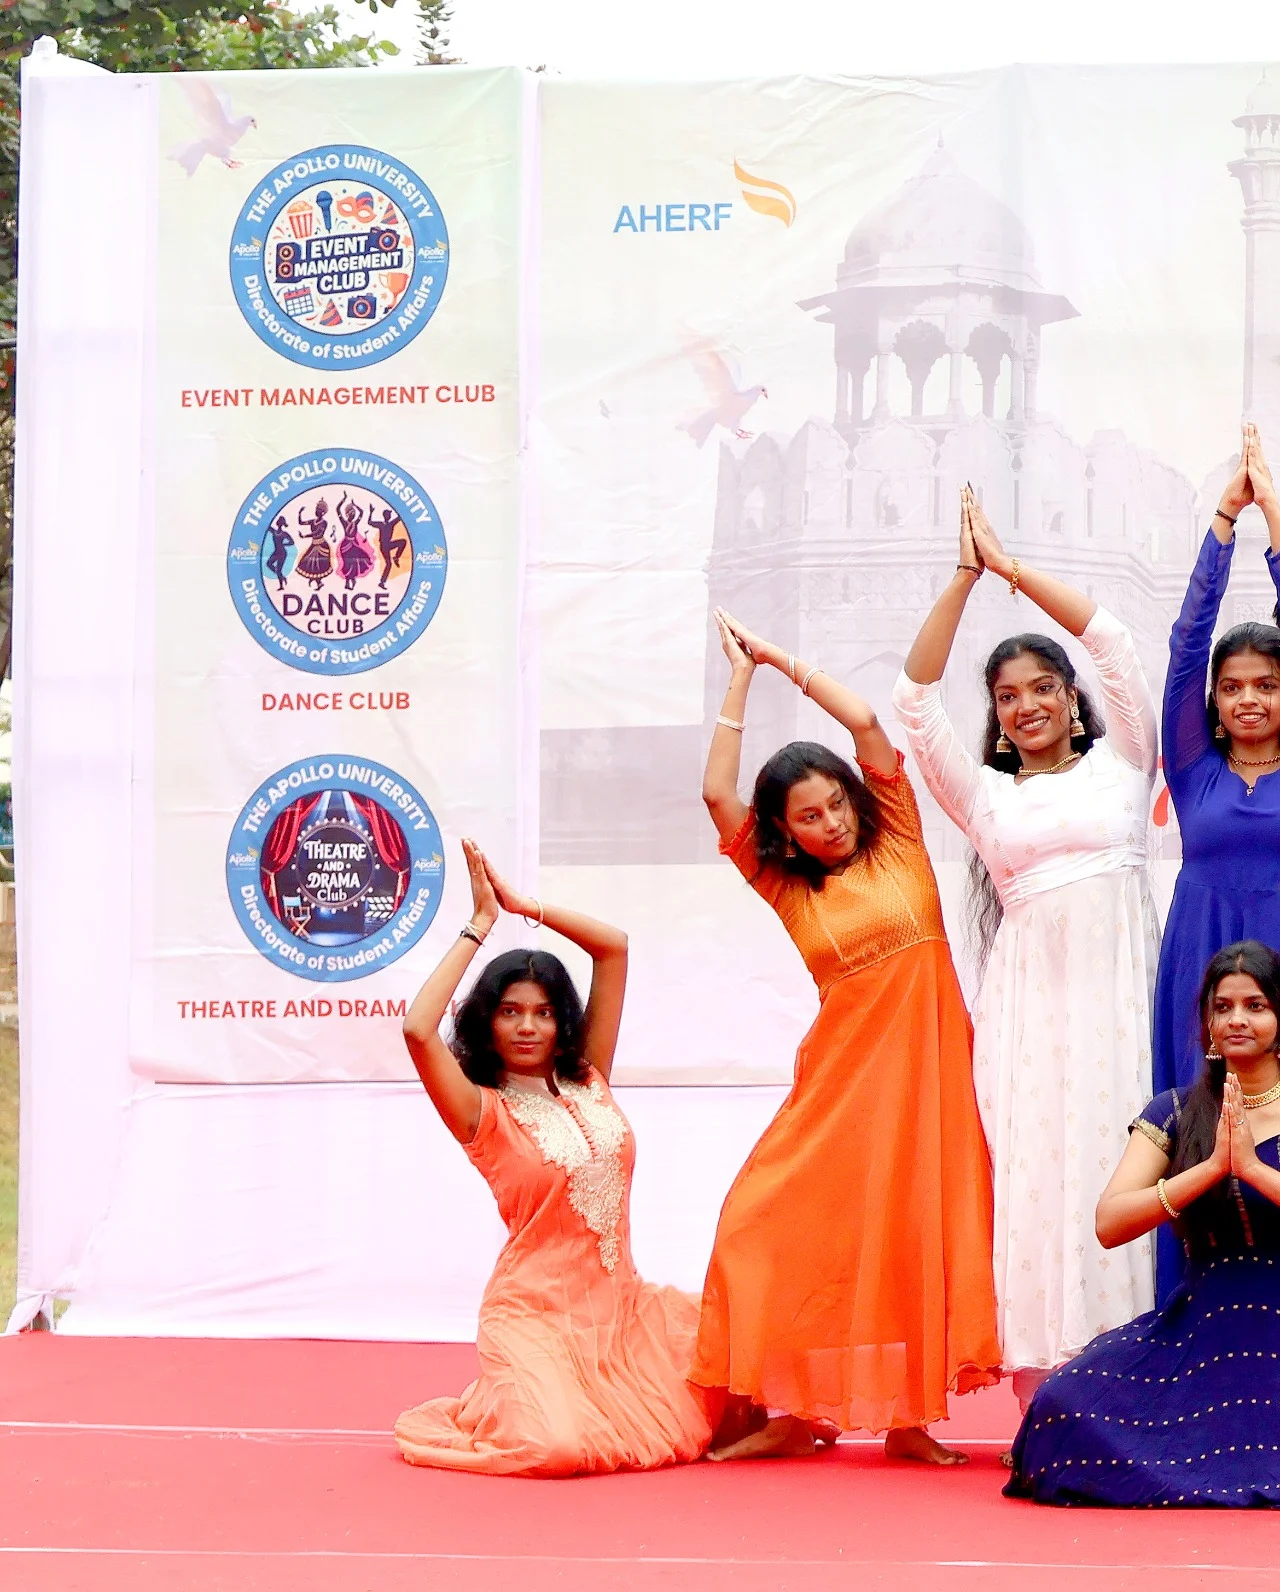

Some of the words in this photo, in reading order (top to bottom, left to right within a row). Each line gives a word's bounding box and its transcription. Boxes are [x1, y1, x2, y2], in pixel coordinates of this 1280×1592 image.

[247, 188, 276, 223] THE
[273, 153, 340, 195] APOLLO
[343, 153, 434, 219] UNIVERSITY
[613, 203, 733, 233] AHERF
[310, 235, 369, 260] EVENT
[293, 251, 401, 278] MANAGEMENT
[319, 271, 367, 293] CLUB
[244, 274, 311, 353] Directorate
[311, 343, 331, 359] of
[332, 325, 401, 360] Student
[397, 275, 434, 332] Affairs
[181, 389, 254, 407] EVENT
[259, 386, 429, 406] MANAGEMENT
[435, 384, 496, 403] CLUB
[242, 491, 273, 526] THE
[269, 457, 337, 498] APOLLO
[340, 456, 432, 524] UNIVERSITY
[416, 552, 443, 564] Apollo
[282, 592, 390, 617] DANCE
[241, 578, 308, 658] Directorate
[309, 647, 329, 664] of
[329, 630, 399, 664] Student
[395, 580, 432, 637] Affairs
[307, 618, 364, 634] CLUB
[262, 693, 343, 711] DANCE
[349, 691, 411, 710] CLUB
[241, 797, 272, 833] THE
[267, 762, 335, 805] APOLLO
[337, 762, 430, 831] UNIVERSITY
[303, 839, 367, 861] THEATRE
[322, 861, 345, 871] AND
[414, 860, 440, 872] Apollo
[305, 871, 361, 889] DRAMA
[316, 887, 347, 902] Club
[240, 884, 306, 965] Directorate
[307, 954, 325, 971] of
[326, 937, 394, 972] Student
[391, 887, 430, 944] Affairs
[177, 1001, 277, 1019] THEATRE
[283, 1000, 333, 1018] AND
[338, 999, 407, 1018] DRAM
